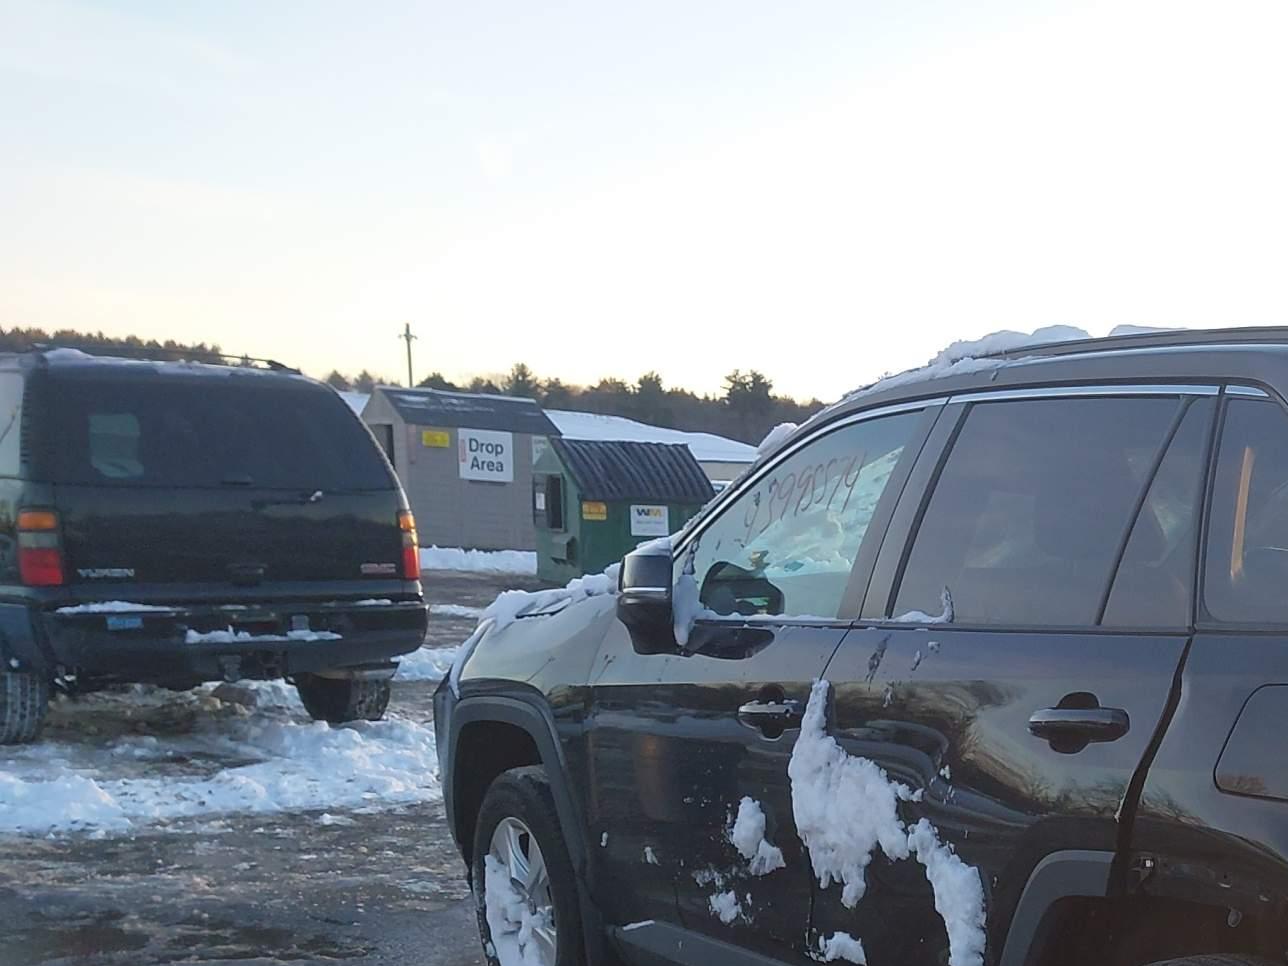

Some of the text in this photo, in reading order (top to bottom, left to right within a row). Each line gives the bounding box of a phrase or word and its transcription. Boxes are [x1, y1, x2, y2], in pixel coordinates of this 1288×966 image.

[468, 438, 504, 456] Drop
[470, 456, 504, 472] Area
[636, 508, 663, 517] WM
